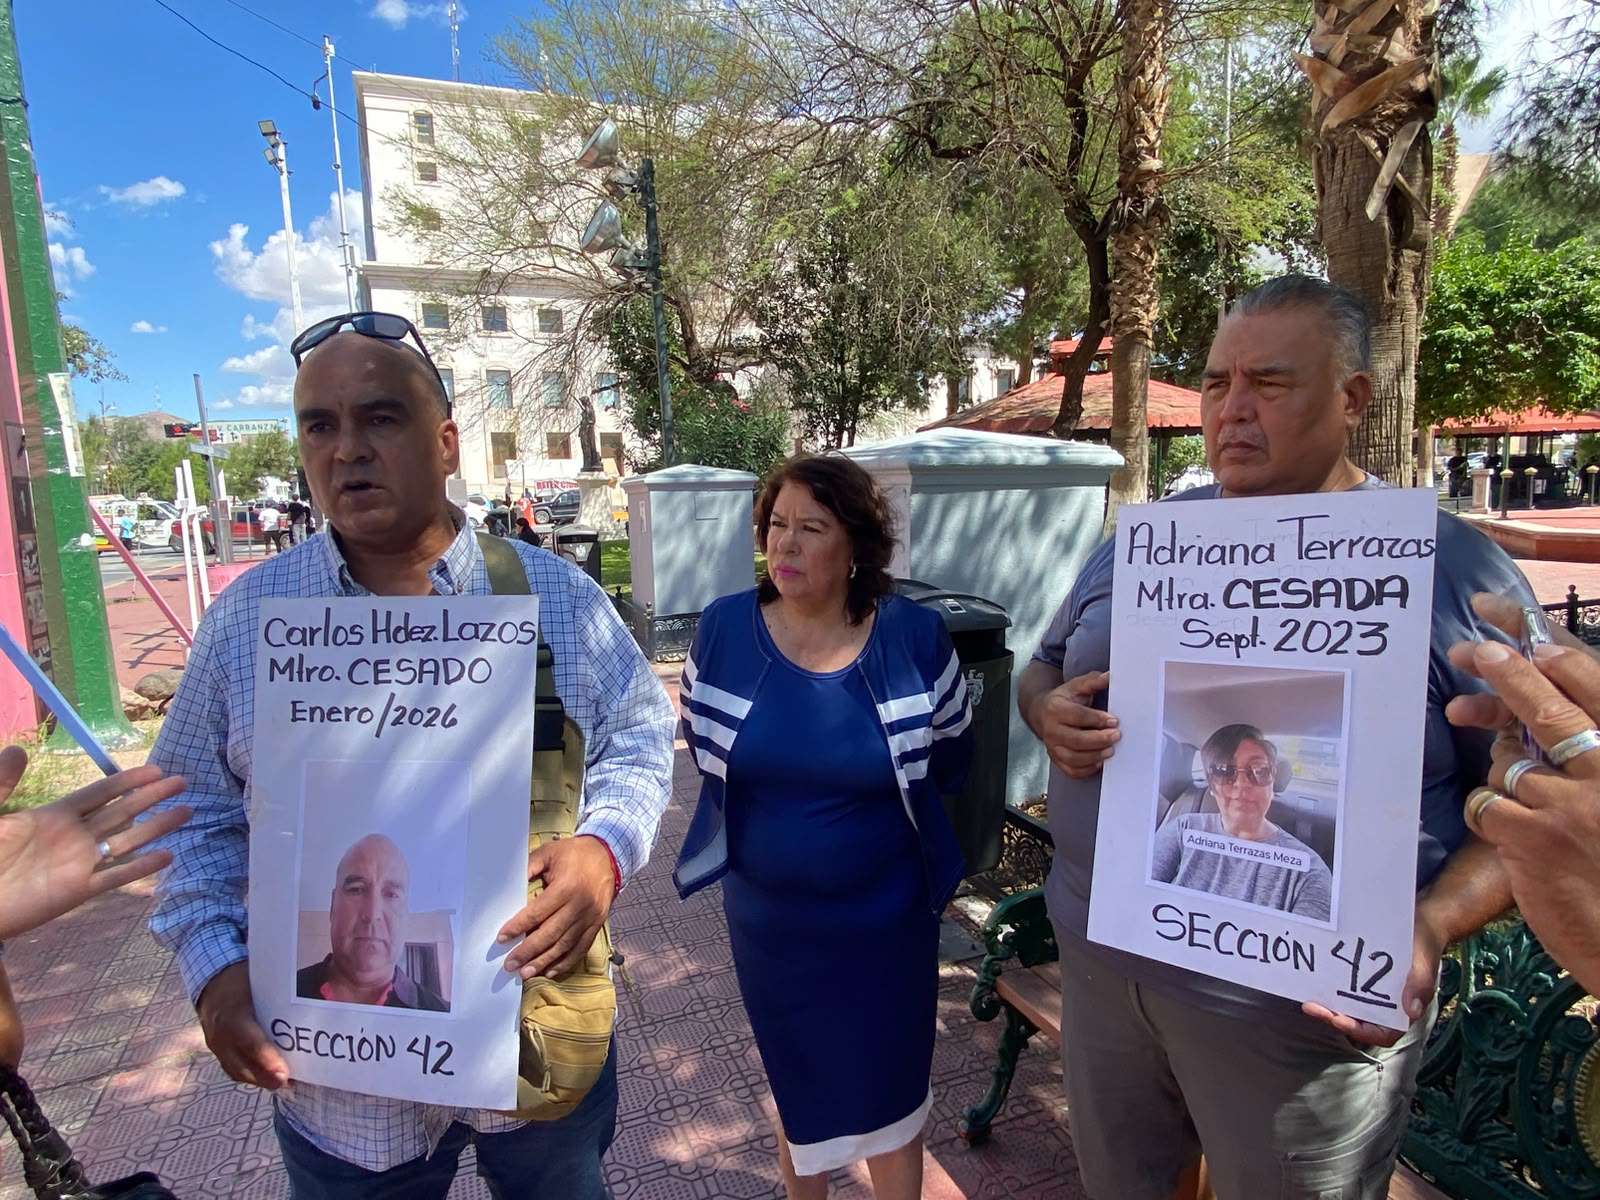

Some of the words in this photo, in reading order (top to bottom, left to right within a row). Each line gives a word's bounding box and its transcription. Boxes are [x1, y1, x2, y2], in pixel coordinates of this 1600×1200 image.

[1127, 520, 1275, 566] Adriana
[1277, 514, 1436, 561] Terrazas
[1222, 574, 1410, 612] CESADA
[264, 606, 364, 648] Carlos
[371, 608, 438, 645] Hdez.
[442, 608, 537, 645] Lazos
[1179, 615, 1266, 658] Sept.
[1273, 618, 1390, 656] 2023
[347, 657, 492, 686] CESADO
[290, 692, 458, 738] Enero/2026
[1186, 834, 1226, 851] Adriana
[1227, 842, 1272, 860] Terrazas
[1273, 852, 1303, 867] Meza
[1152, 903, 1315, 972] SECCIÓN
[1331, 937, 1394, 1001] 42
[271, 1018, 396, 1063] SECCIÓN
[407, 1034, 455, 1076] 42
